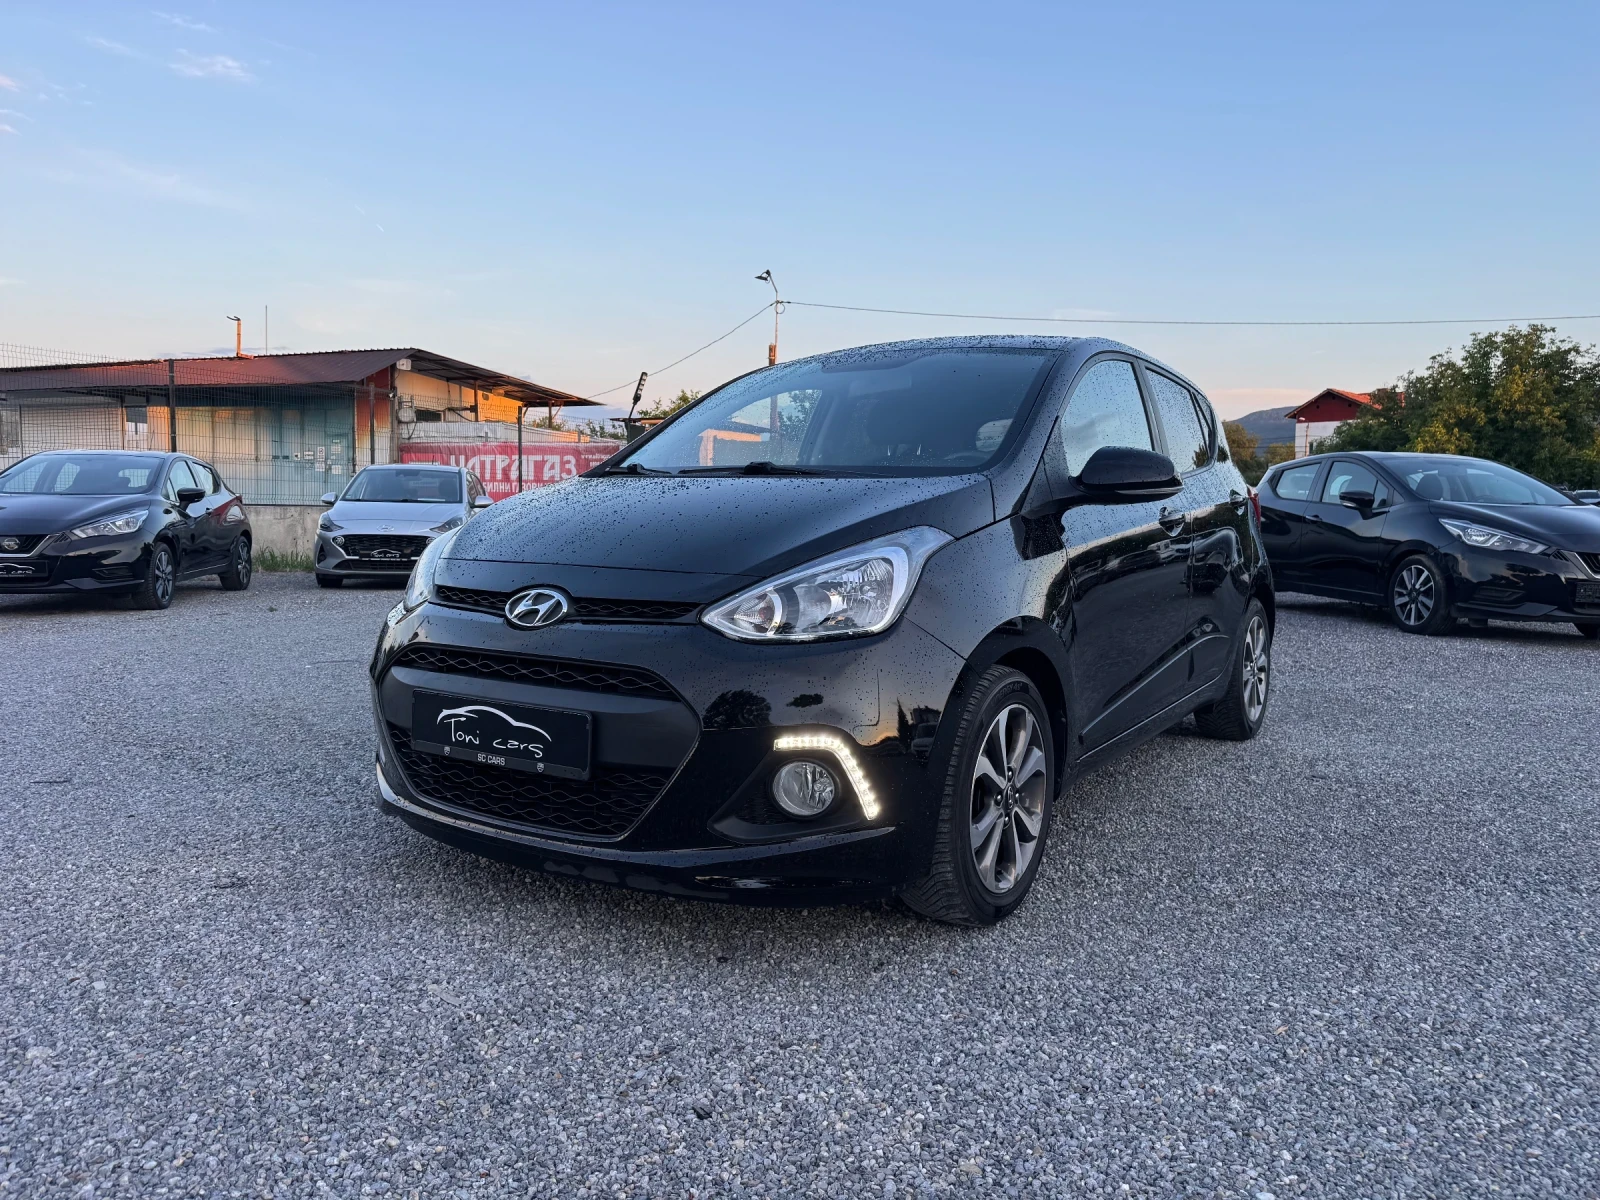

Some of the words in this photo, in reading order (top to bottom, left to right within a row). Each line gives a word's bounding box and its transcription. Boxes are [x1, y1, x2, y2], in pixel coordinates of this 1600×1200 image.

[443, 717, 480, 744] Toni
[492, 738, 544, 758] cars
[477, 753, 487, 762] SC
[487, 755, 506, 766] CARS
